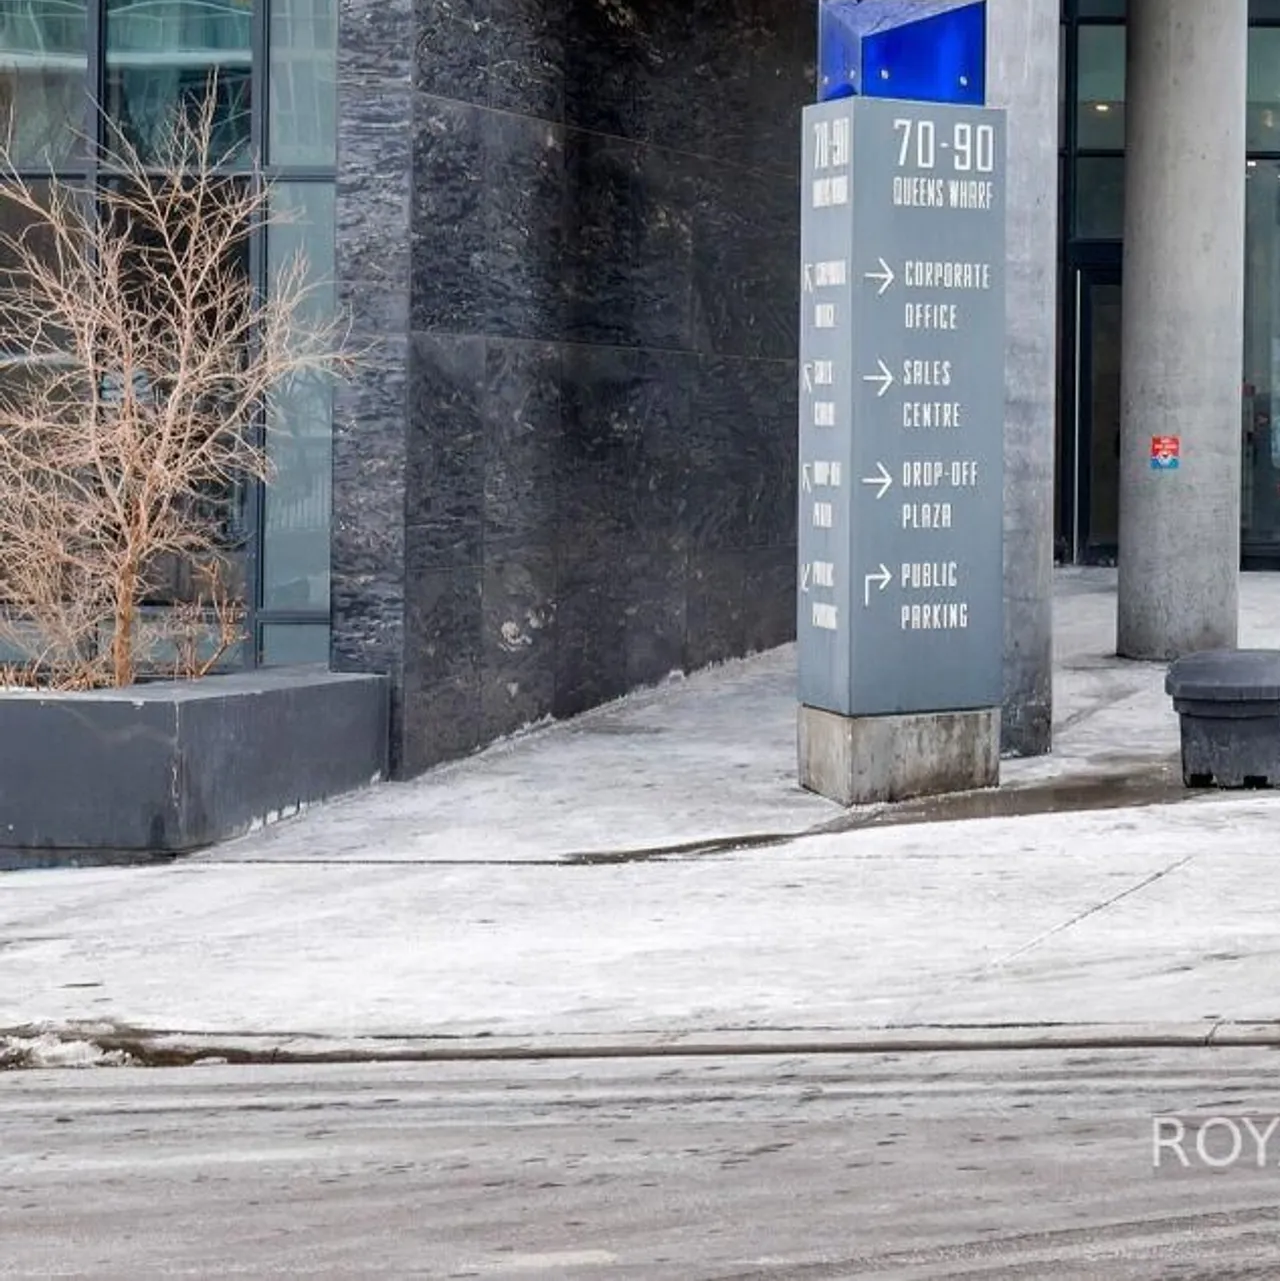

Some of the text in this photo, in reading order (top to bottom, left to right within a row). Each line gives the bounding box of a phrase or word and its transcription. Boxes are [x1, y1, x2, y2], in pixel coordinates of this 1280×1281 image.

[893, 119, 994, 172] 70-90
[893, 177, 994, 209] QUEENS WHARF
[905, 260, 990, 289] CORPORATE
[905, 304, 957, 329] OFFICE
[903, 360, 951, 386] SALES
[903, 402, 960, 428] CENTRE
[903, 462, 978, 487] DROP-OFF
[903, 504, 951, 528] PLAZA
[901, 563, 957, 588] PUBLIC
[901, 604, 968, 630] PARKING
